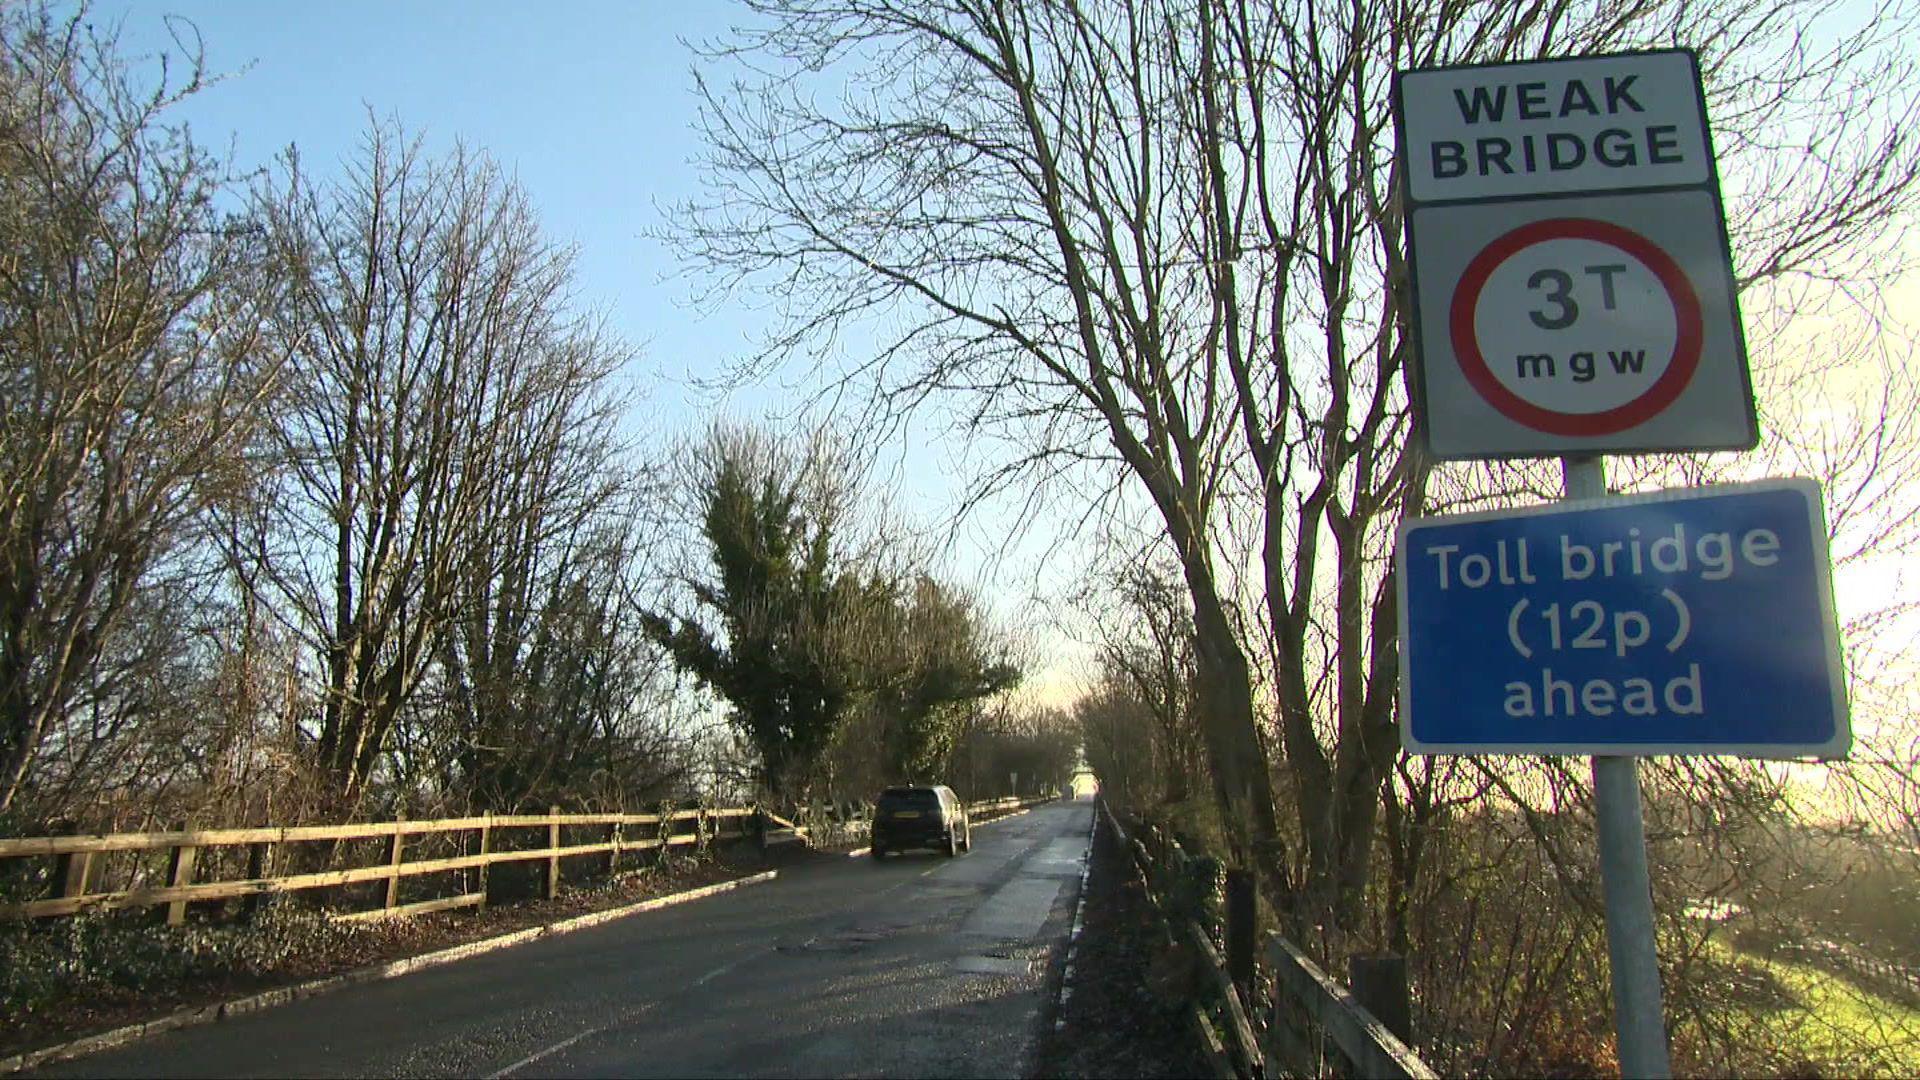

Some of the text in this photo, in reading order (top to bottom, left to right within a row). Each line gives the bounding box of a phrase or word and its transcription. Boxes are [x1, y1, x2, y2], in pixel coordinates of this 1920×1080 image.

[1454, 74, 1646, 124] WEAK
[1432, 125, 1685, 179] BRIDGE
[1427, 523, 1780, 590] Toll bridge
[1507, 588, 1691, 657] (12p)
[1503, 664, 1704, 718] ahead
